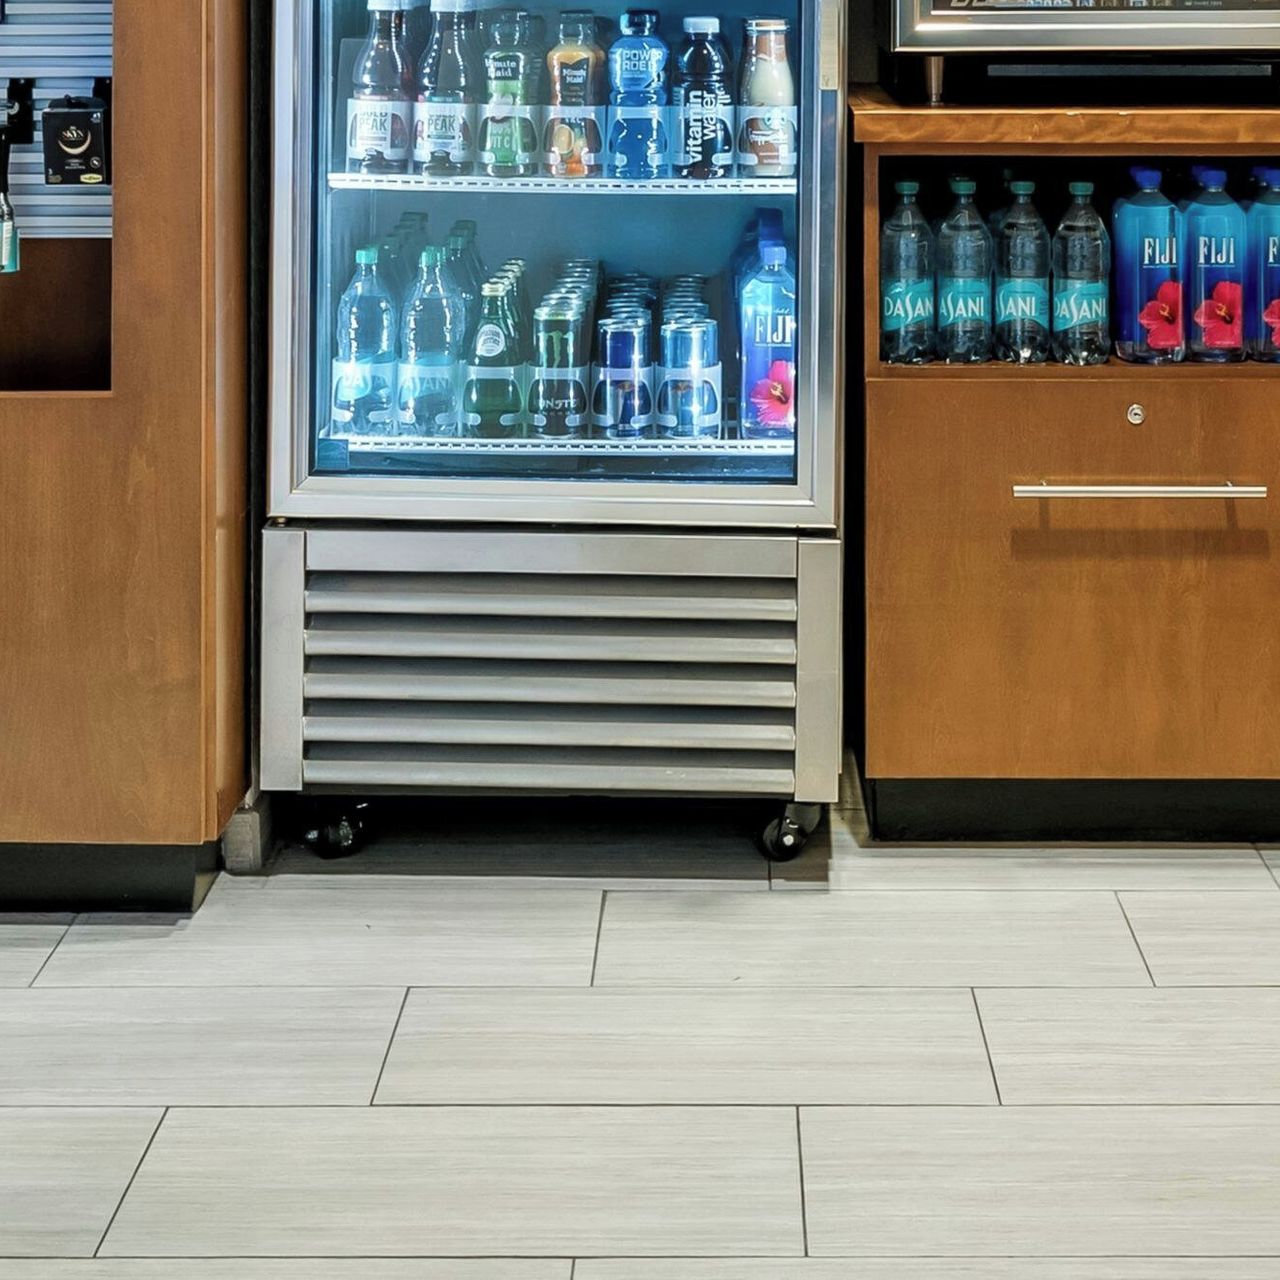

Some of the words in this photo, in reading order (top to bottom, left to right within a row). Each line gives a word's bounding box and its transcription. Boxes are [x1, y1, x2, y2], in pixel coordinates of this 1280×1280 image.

[427, 118, 455, 131] PEAK
[686, 90, 702, 163] vitamin
[703, 90, 717, 140] water
[1144, 237, 1177, 264] FIJI
[1198, 236, 1235, 264] FIJI
[884, 292, 933, 323] DASAN
[940, 292, 984, 322] ASANI
[996, 290, 1036, 319] SANI
